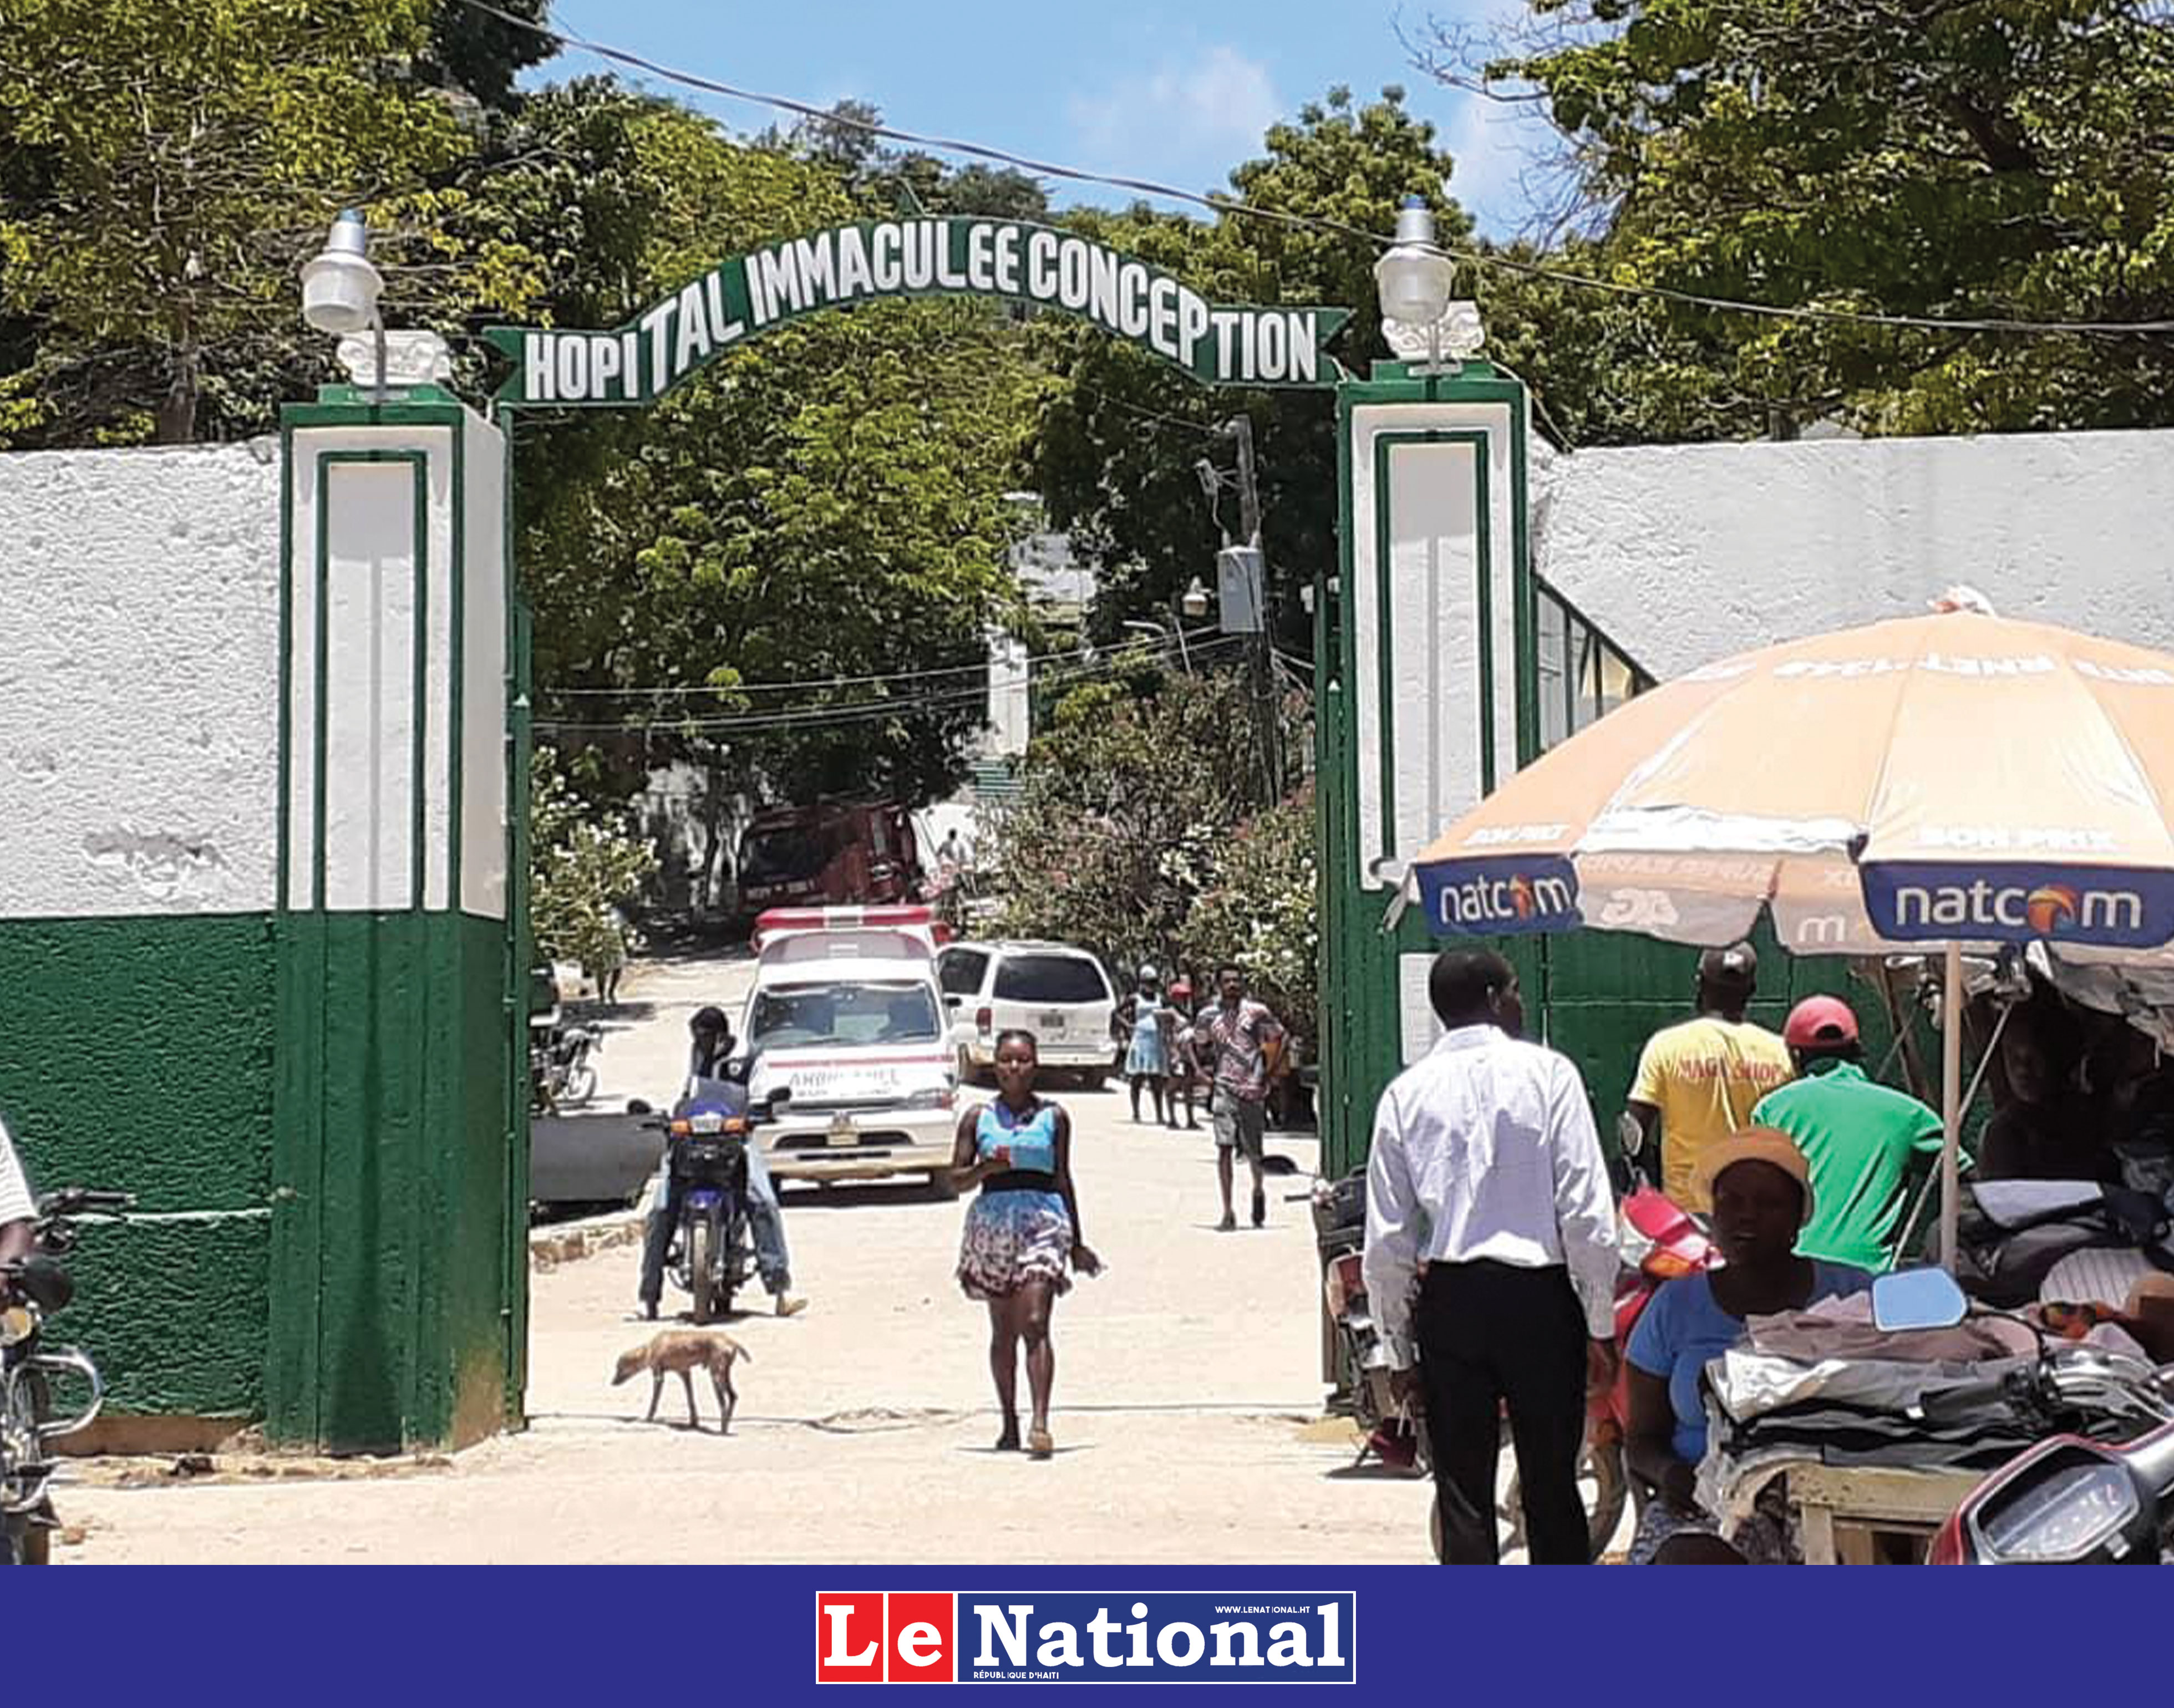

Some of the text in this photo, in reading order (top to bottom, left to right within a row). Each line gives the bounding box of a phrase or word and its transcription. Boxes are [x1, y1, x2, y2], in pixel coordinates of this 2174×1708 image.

[525, 222, 1315, 400] HOPITAL IMMACULEE CONCEPTION
[1440, 874, 1571, 924] natcom
[1896, 880, 2141, 932] natcom
